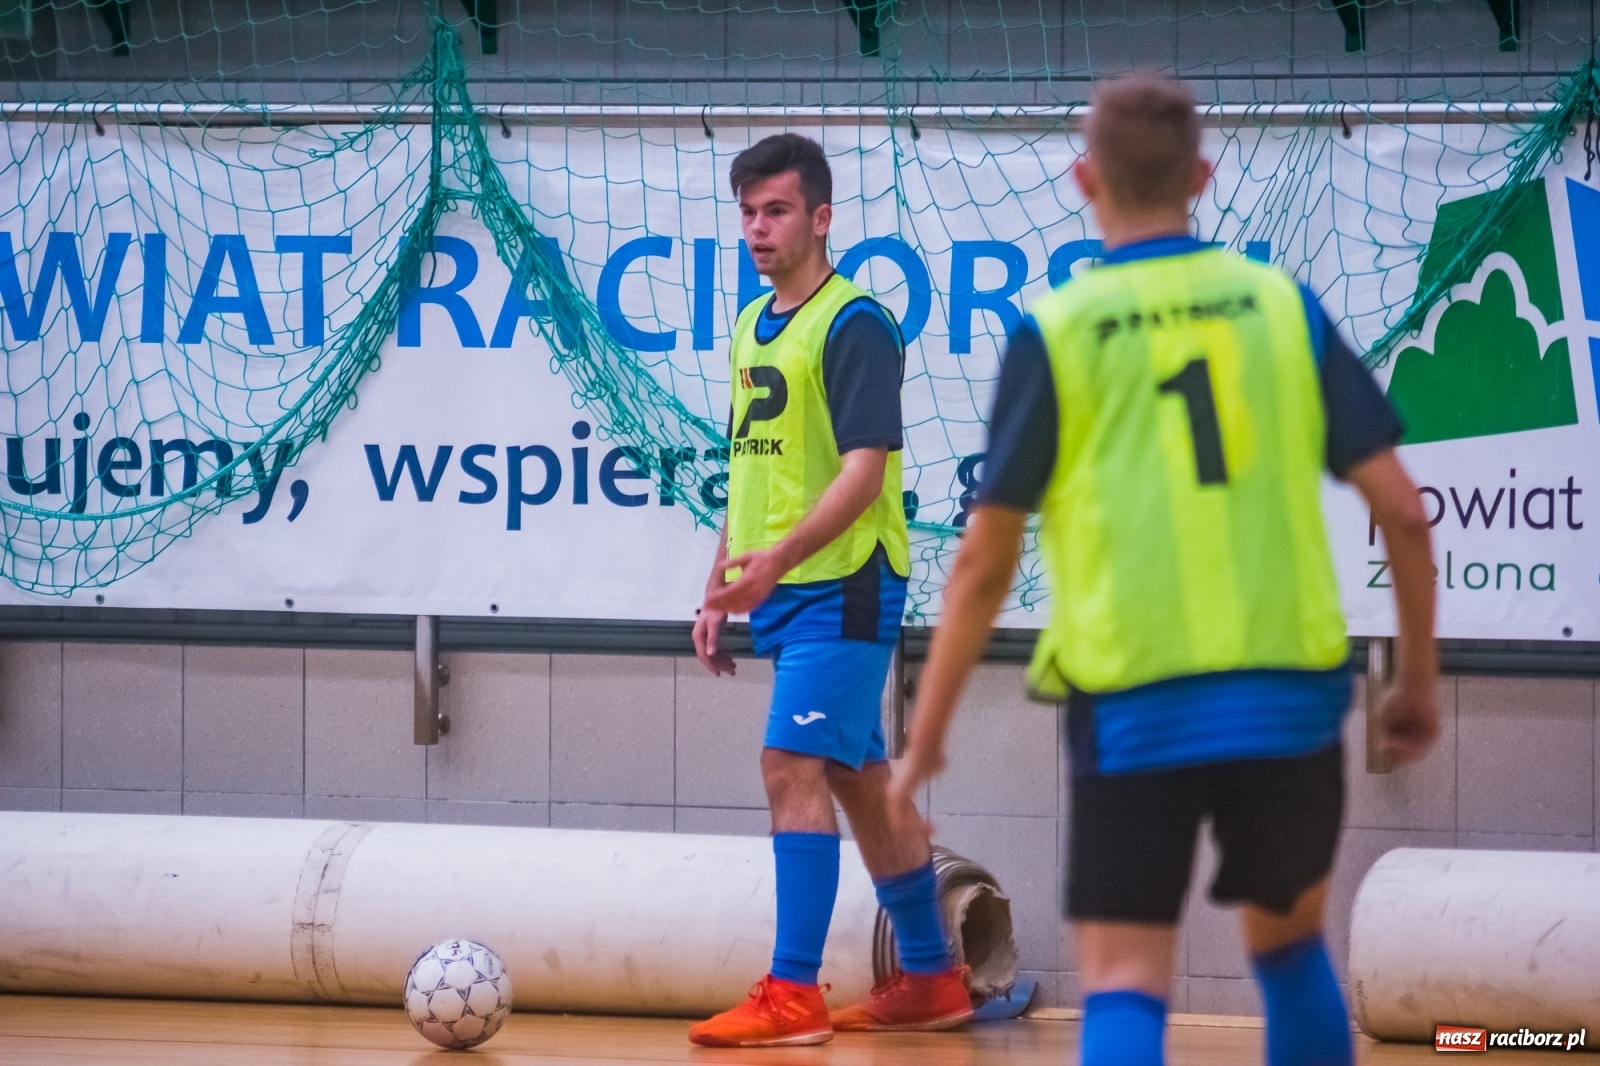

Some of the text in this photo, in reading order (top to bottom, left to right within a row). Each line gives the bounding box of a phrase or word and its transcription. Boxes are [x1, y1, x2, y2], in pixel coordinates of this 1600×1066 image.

[0, 232, 352, 346] WIAT
[6, 412, 310, 525] ujemy,
[733, 438, 784, 457] PATRICK
[1157, 358, 1228, 485] 1
[1367, 550, 1556, 592] zlona
